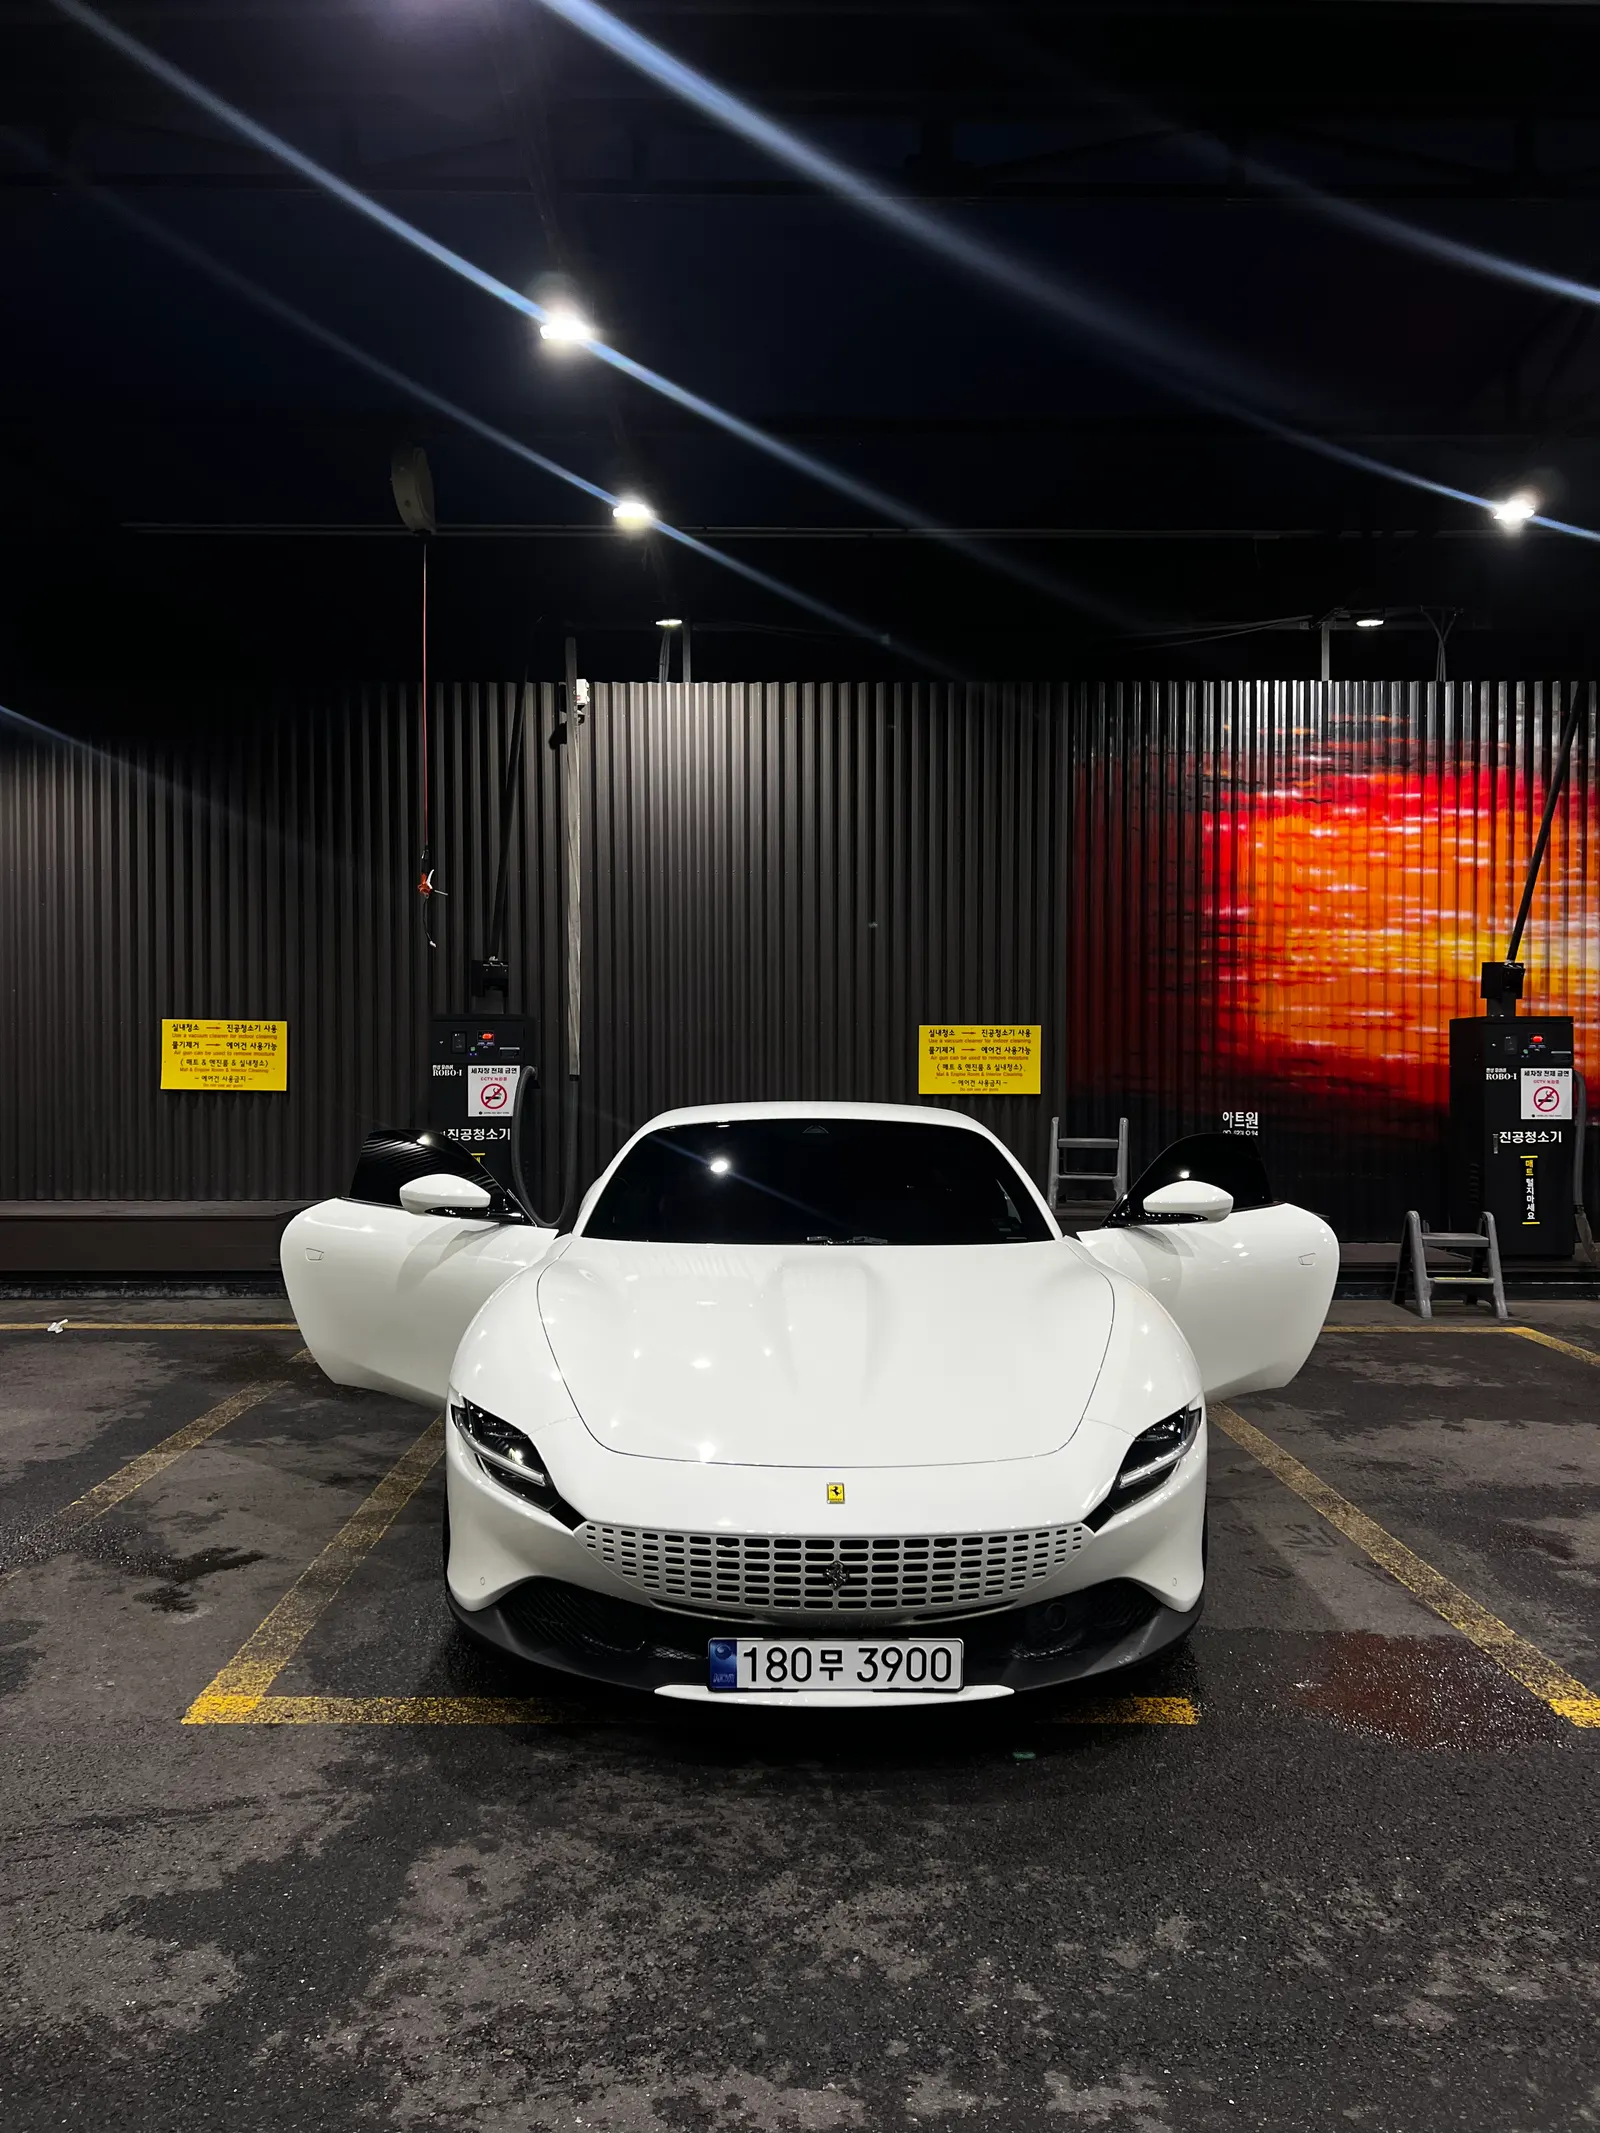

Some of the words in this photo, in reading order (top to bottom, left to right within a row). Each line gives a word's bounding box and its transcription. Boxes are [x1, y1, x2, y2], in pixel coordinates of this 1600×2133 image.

[172, 1024, 199, 1032] 실내청소
[227, 1025, 260, 1033] 진공청소기
[264, 1025, 277, 1033] 사용
[929, 1029, 955, 1037] 실내청소
[981, 1029, 1014, 1037] 진공청소기
[1018, 1029, 1031, 1037] 사용
[226, 1042, 247, 1050] 에어건
[250, 1043, 277, 1051] 사용가능
[1004, 1047, 1031, 1055] 사용가능
[1223, 1112, 1258, 1129] 아트원
[447, 1129, 511, 1141] 진공청소기
[1499, 1131, 1562, 1143] 진공청소기
[1525, 1160, 1533, 1176] 매트
[743, 1647, 844, 1682] 180무
[857, 1647, 952, 1682] 3900
